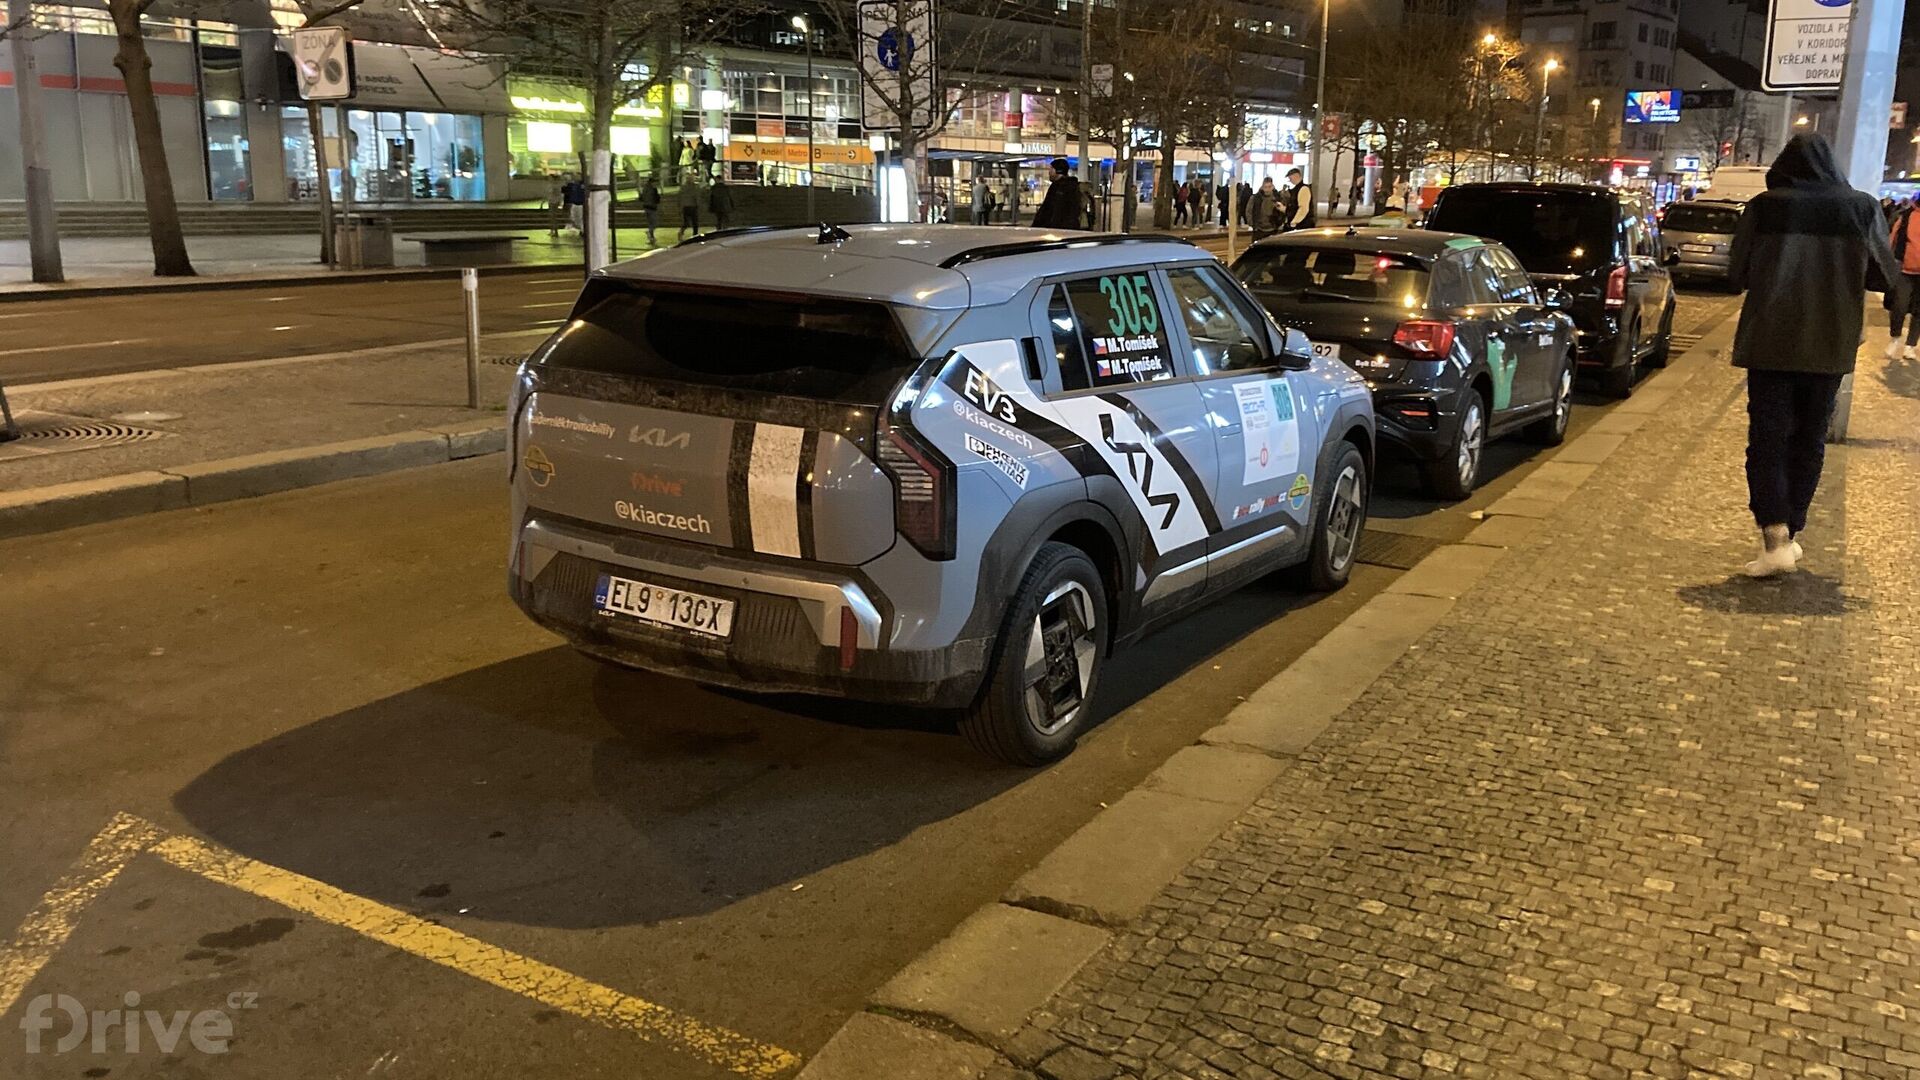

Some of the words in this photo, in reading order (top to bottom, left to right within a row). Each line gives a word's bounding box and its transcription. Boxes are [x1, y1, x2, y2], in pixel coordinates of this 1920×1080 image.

[1797, 22, 1833, 33] VOZIDLA
[1777, 52, 1817, 65] VEŘEJNÉ
[1821, 54, 1828, 63] A
[1797, 40, 1803, 49] V
[356, 86, 397, 95] FFICES
[787, 149, 808, 157] Metro
[814, 148, 822, 159] B
[1100, 275, 1158, 336] 305
[1312, 344, 1332, 356] 92
[963, 367, 1017, 424] EV3
[628, 424, 691, 450] KIA
[952, 400, 1033, 450] @kiaczech
[986, 452, 1025, 486] CONTACT
[1098, 413, 1180, 530] KIA
[615, 500, 711, 534] @kiaczech
[611, 579, 651, 614] EL9
[669, 593, 722, 632] 13CX
